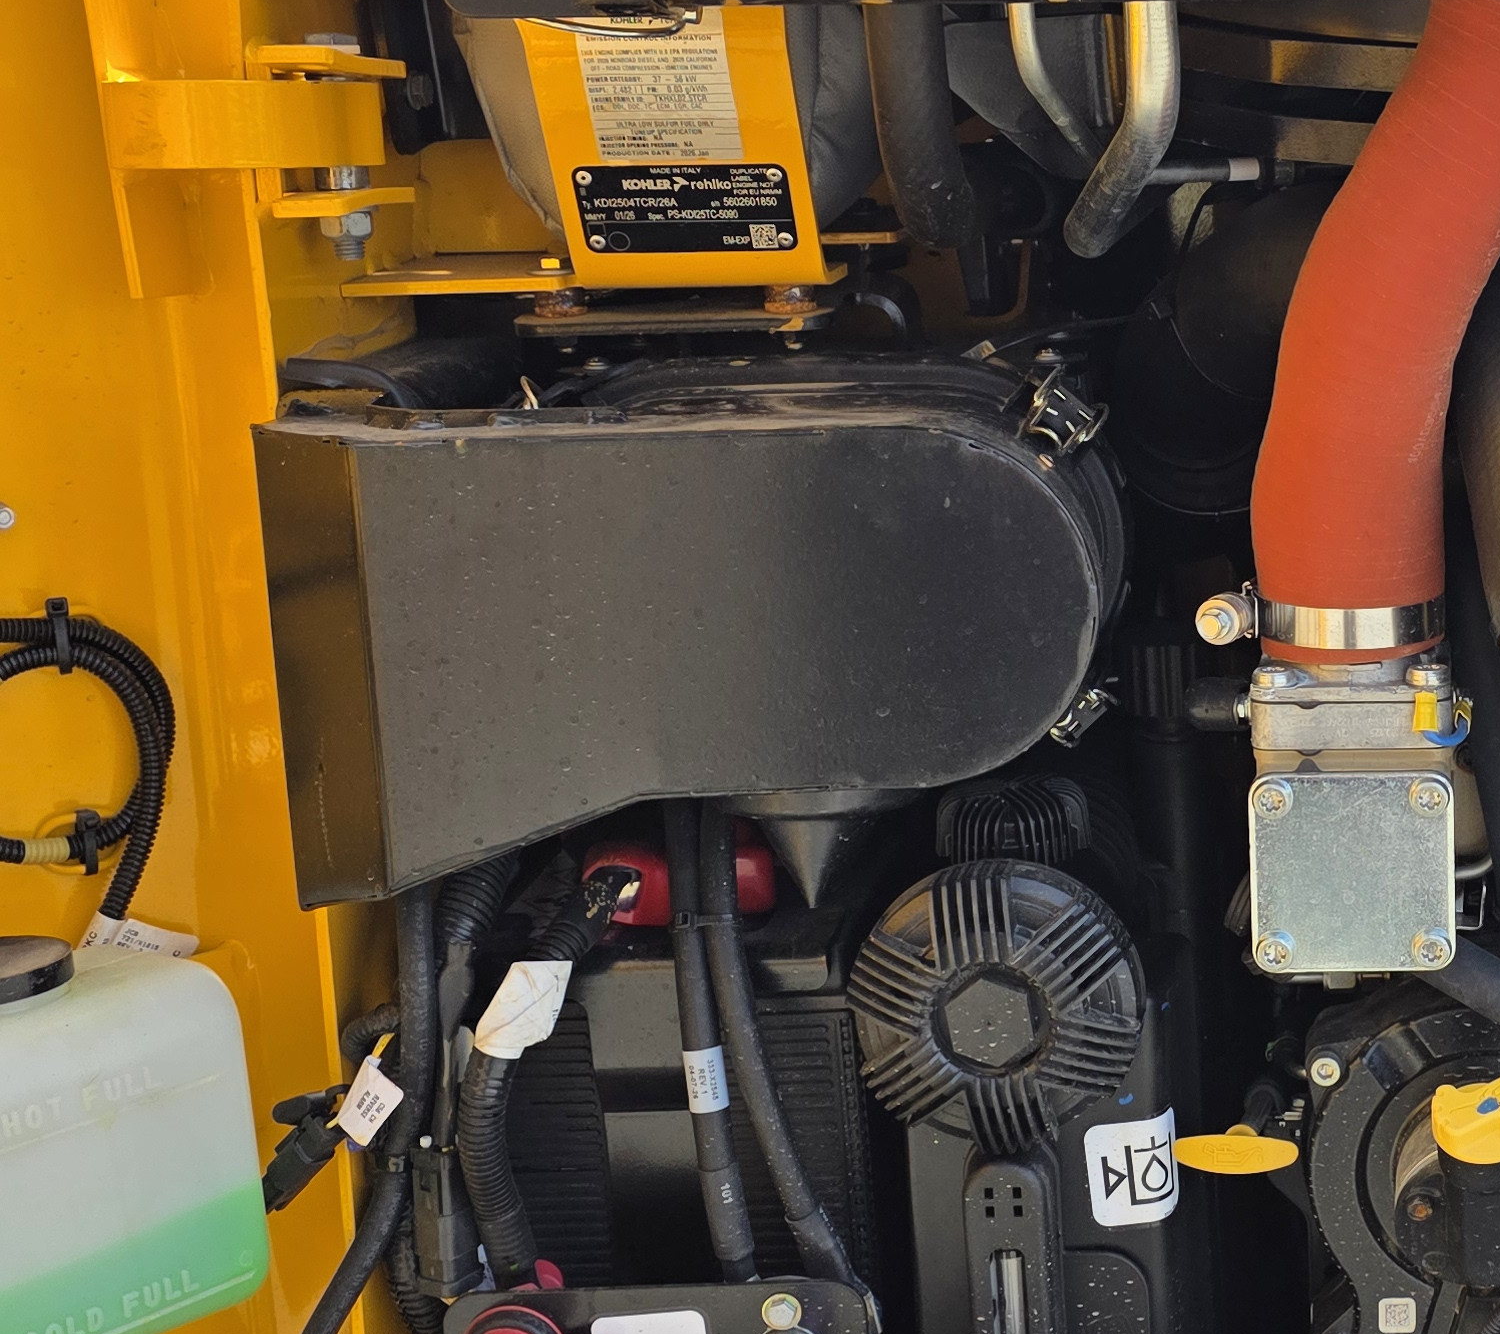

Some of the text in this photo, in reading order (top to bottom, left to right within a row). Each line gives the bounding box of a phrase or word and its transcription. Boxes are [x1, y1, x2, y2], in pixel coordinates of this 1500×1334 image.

[621, 179, 672, 190] KOHLER
[690, 179, 732, 190] rehlko
[593, 197, 678, 208] KDI2504TCR/26A
[614, 211, 636, 220] 01/26
[1, 1067, 154, 1138] HOT FULL
[121, 1269, 200, 1318] FULL
